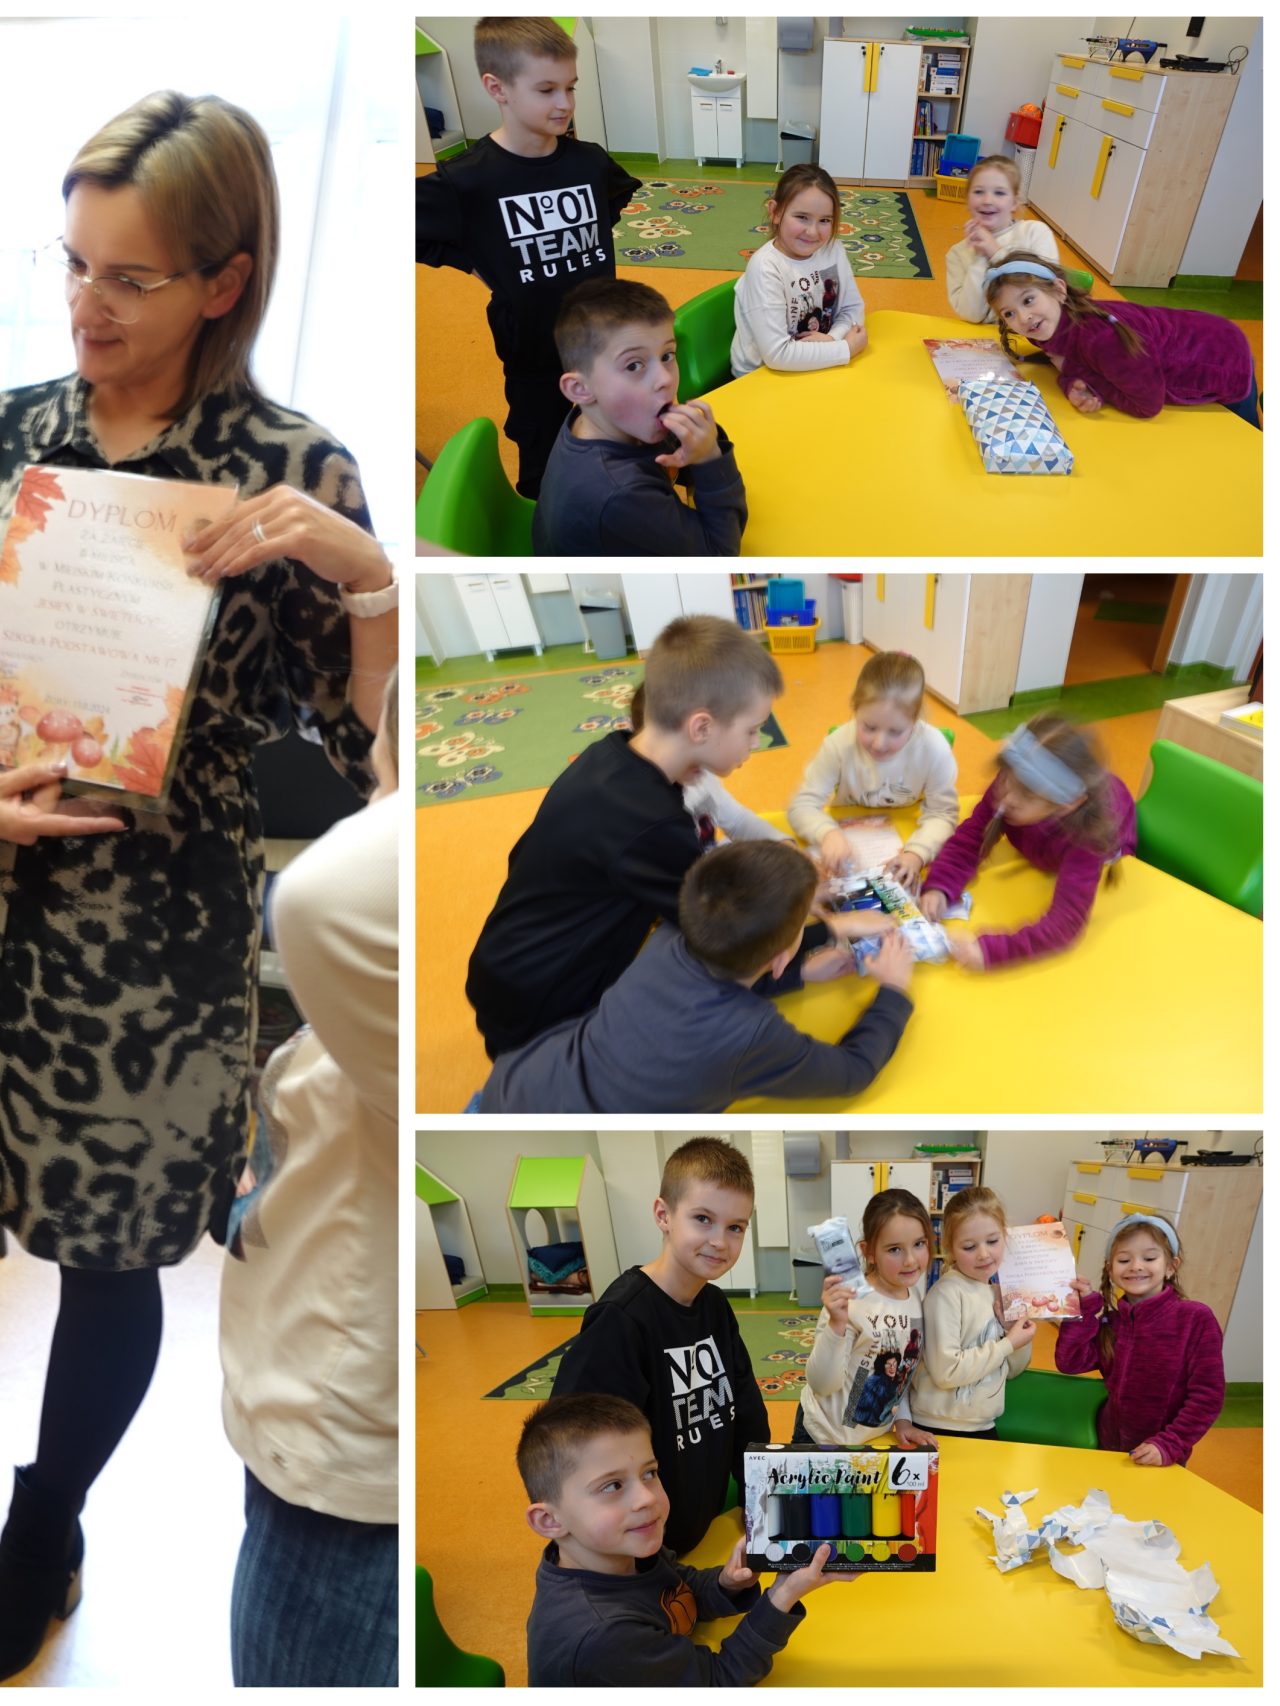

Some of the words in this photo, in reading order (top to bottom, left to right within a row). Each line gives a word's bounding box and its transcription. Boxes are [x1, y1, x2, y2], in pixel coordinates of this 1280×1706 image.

[510, 223, 599, 265] TEAM
[519, 248, 606, 283] RULES
[67, 499, 178, 533] DYPLOM
[866, 1314, 908, 1330] YOU
[676, 1405, 735, 1451] RUES
[768, 1467, 830, 1489] Acrylic
[835, 1468, 882, 1485] Paint
